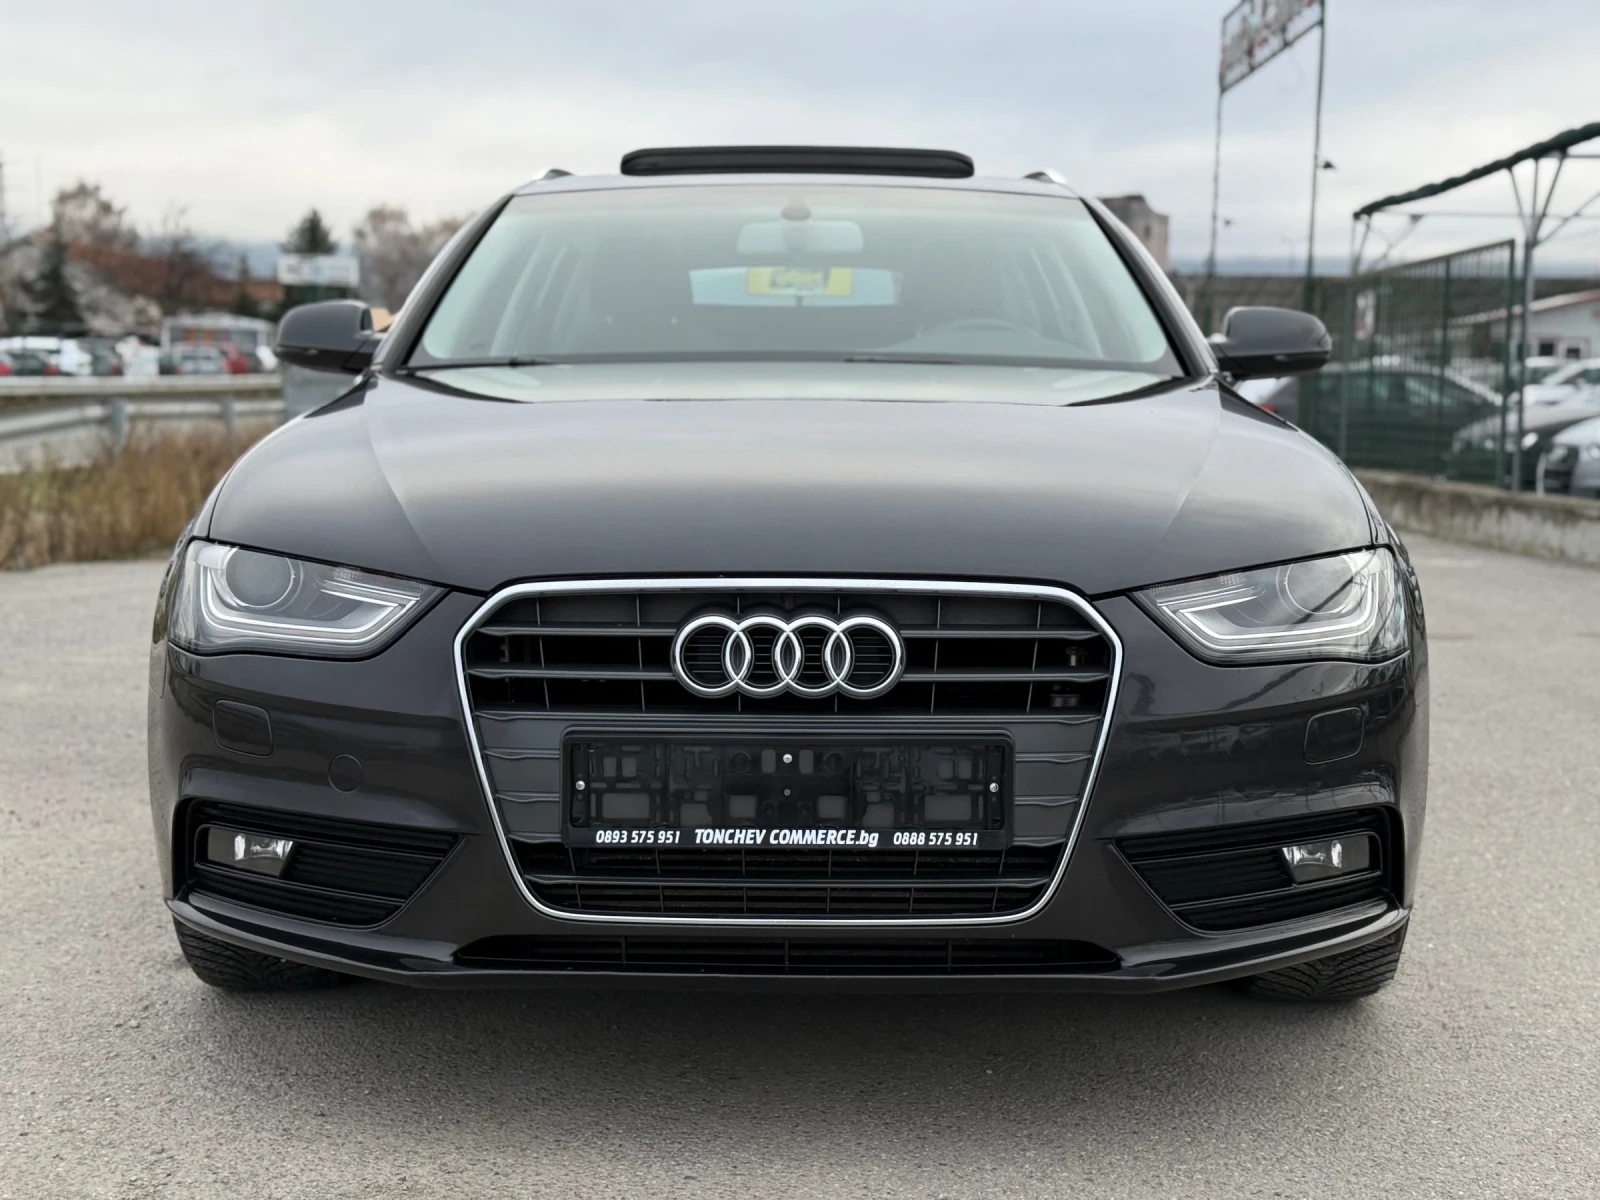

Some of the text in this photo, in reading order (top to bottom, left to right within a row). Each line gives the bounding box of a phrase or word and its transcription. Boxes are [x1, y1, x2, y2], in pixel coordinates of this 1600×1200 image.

[596, 828, 978, 848] 0893 575 951 TONCHEV COMMERCE.bg 0888 575 951
